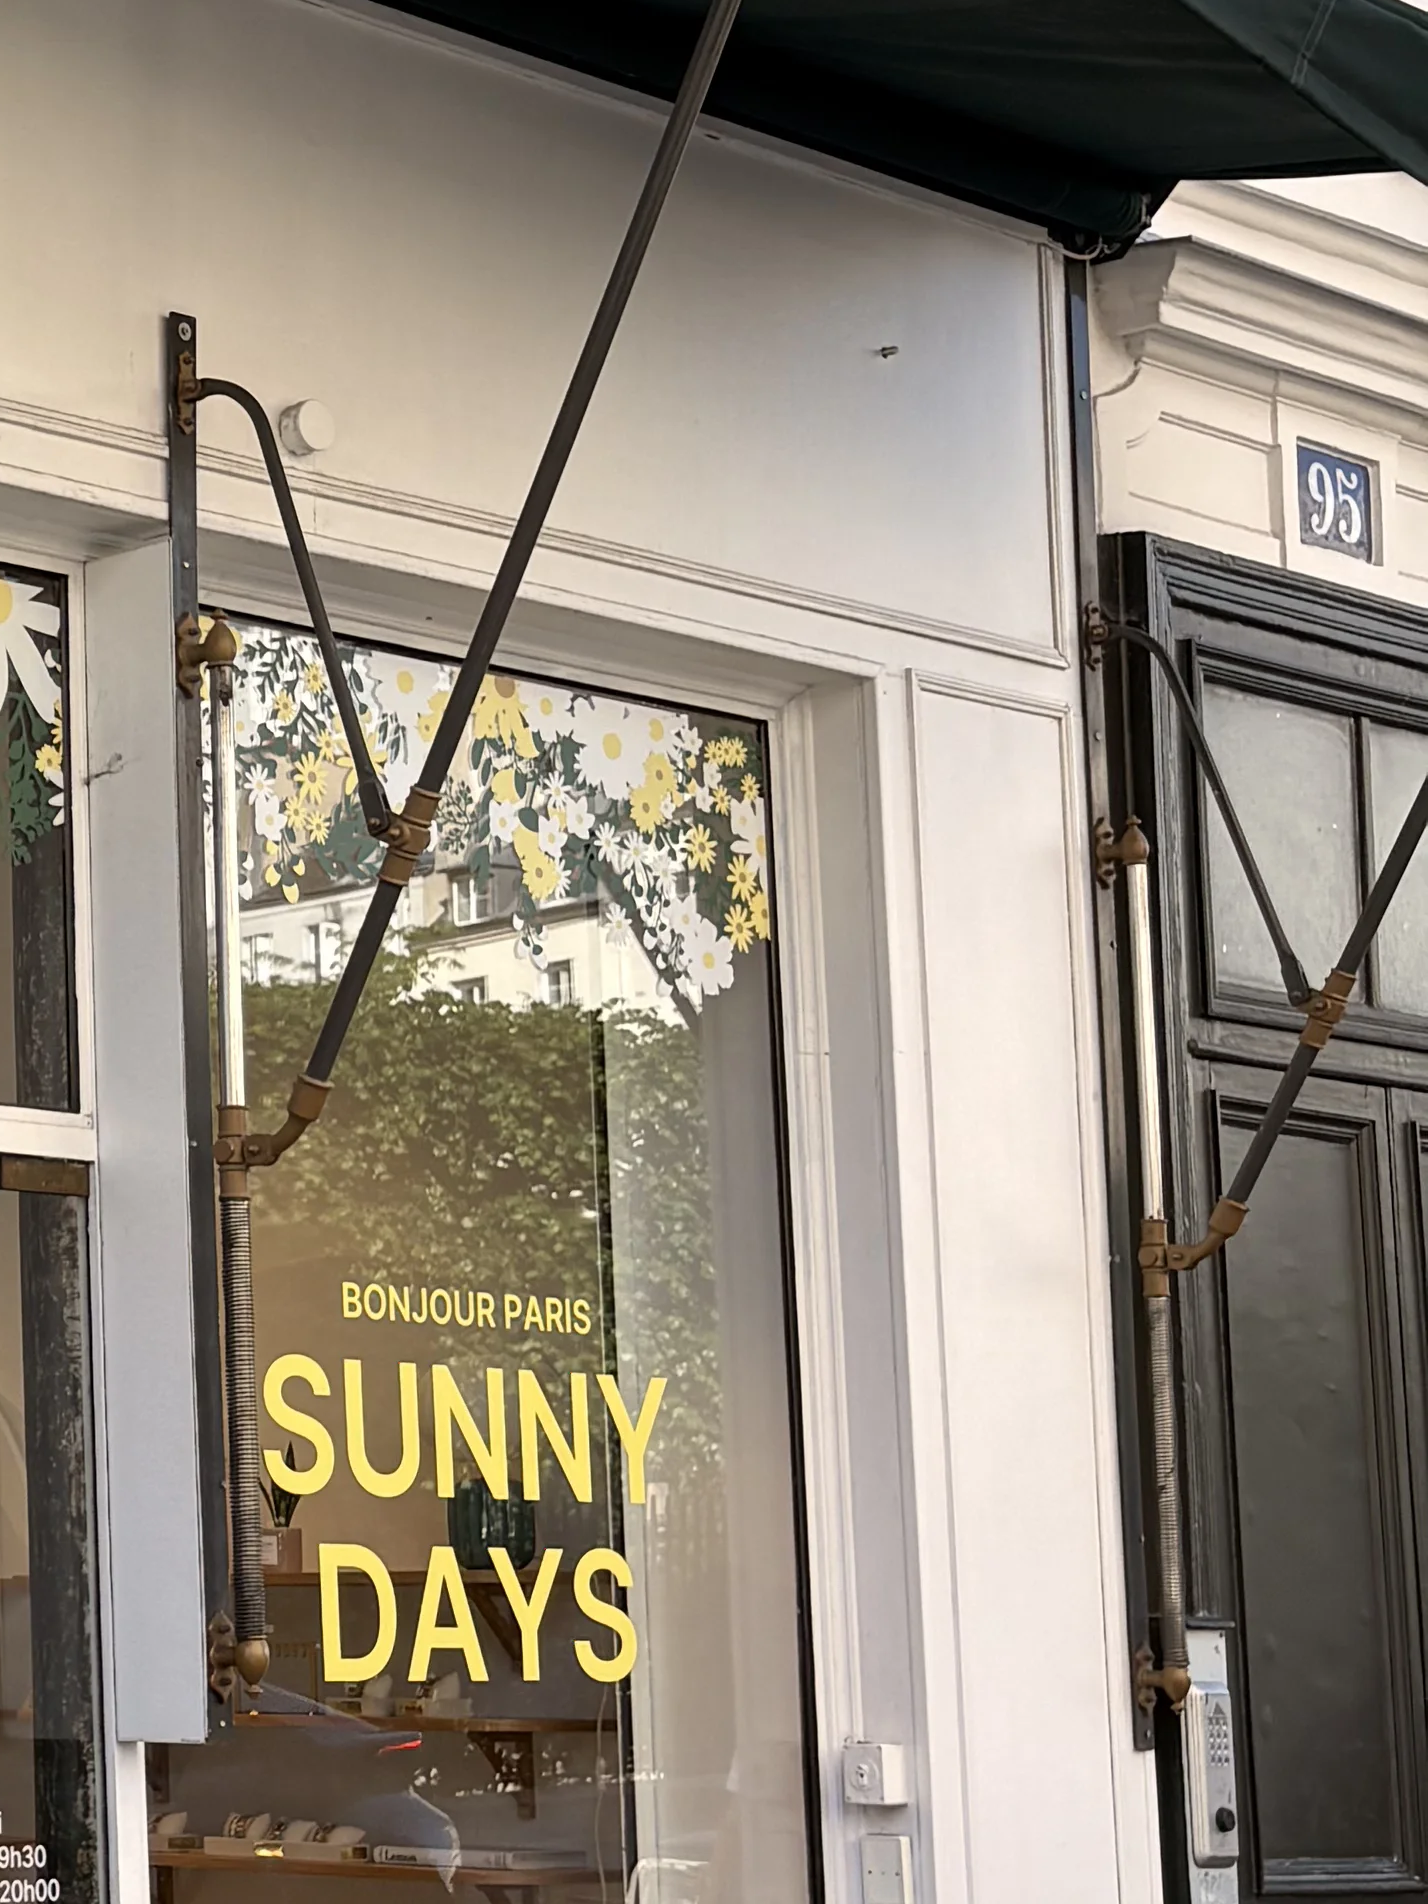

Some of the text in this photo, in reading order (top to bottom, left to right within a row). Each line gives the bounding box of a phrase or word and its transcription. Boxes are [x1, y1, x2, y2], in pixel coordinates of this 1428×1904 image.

[1308, 461, 1362, 543] 95
[341, 1282, 592, 1335] BONJOUR PARIS
[263, 1353, 667, 1505] SUNNY
[318, 1543, 638, 1683] DAYS
